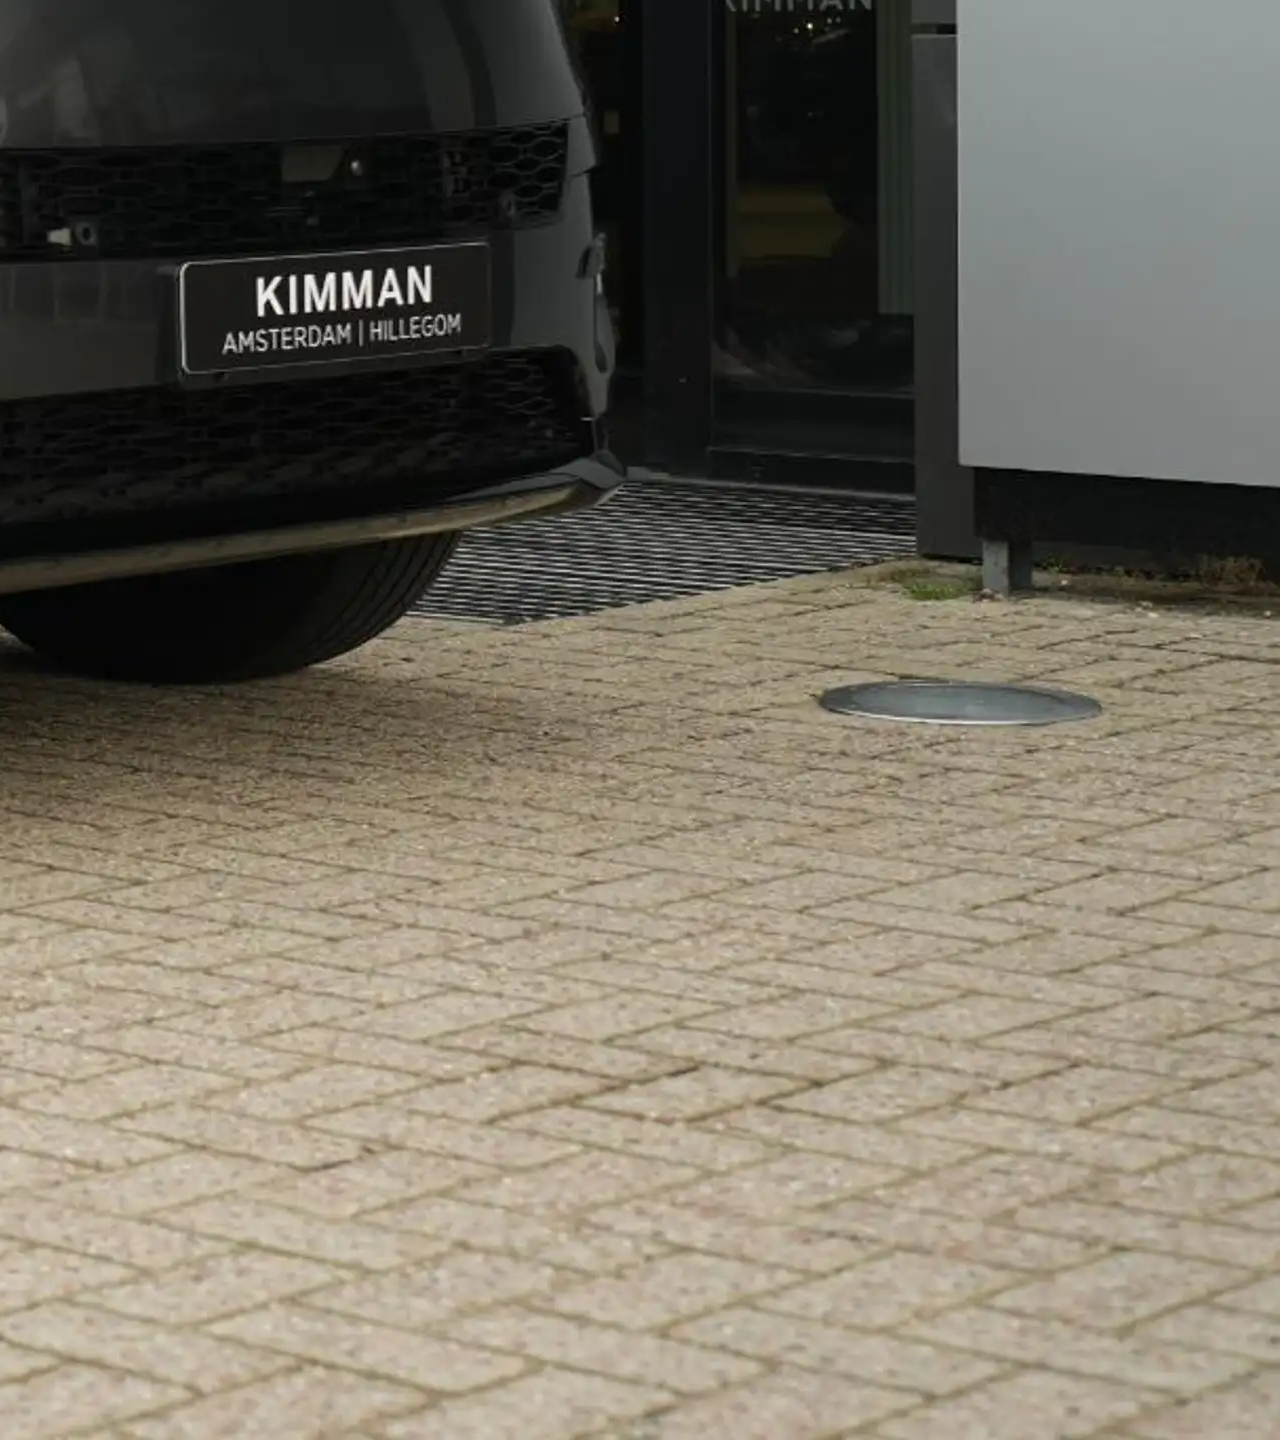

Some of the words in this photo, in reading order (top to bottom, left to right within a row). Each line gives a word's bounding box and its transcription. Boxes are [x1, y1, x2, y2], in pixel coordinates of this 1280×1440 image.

[255, 264, 433, 318] KIMMAN
[221, 322, 352, 356] AMSTERDAM
[369, 312, 462, 342] HILLEGOM
